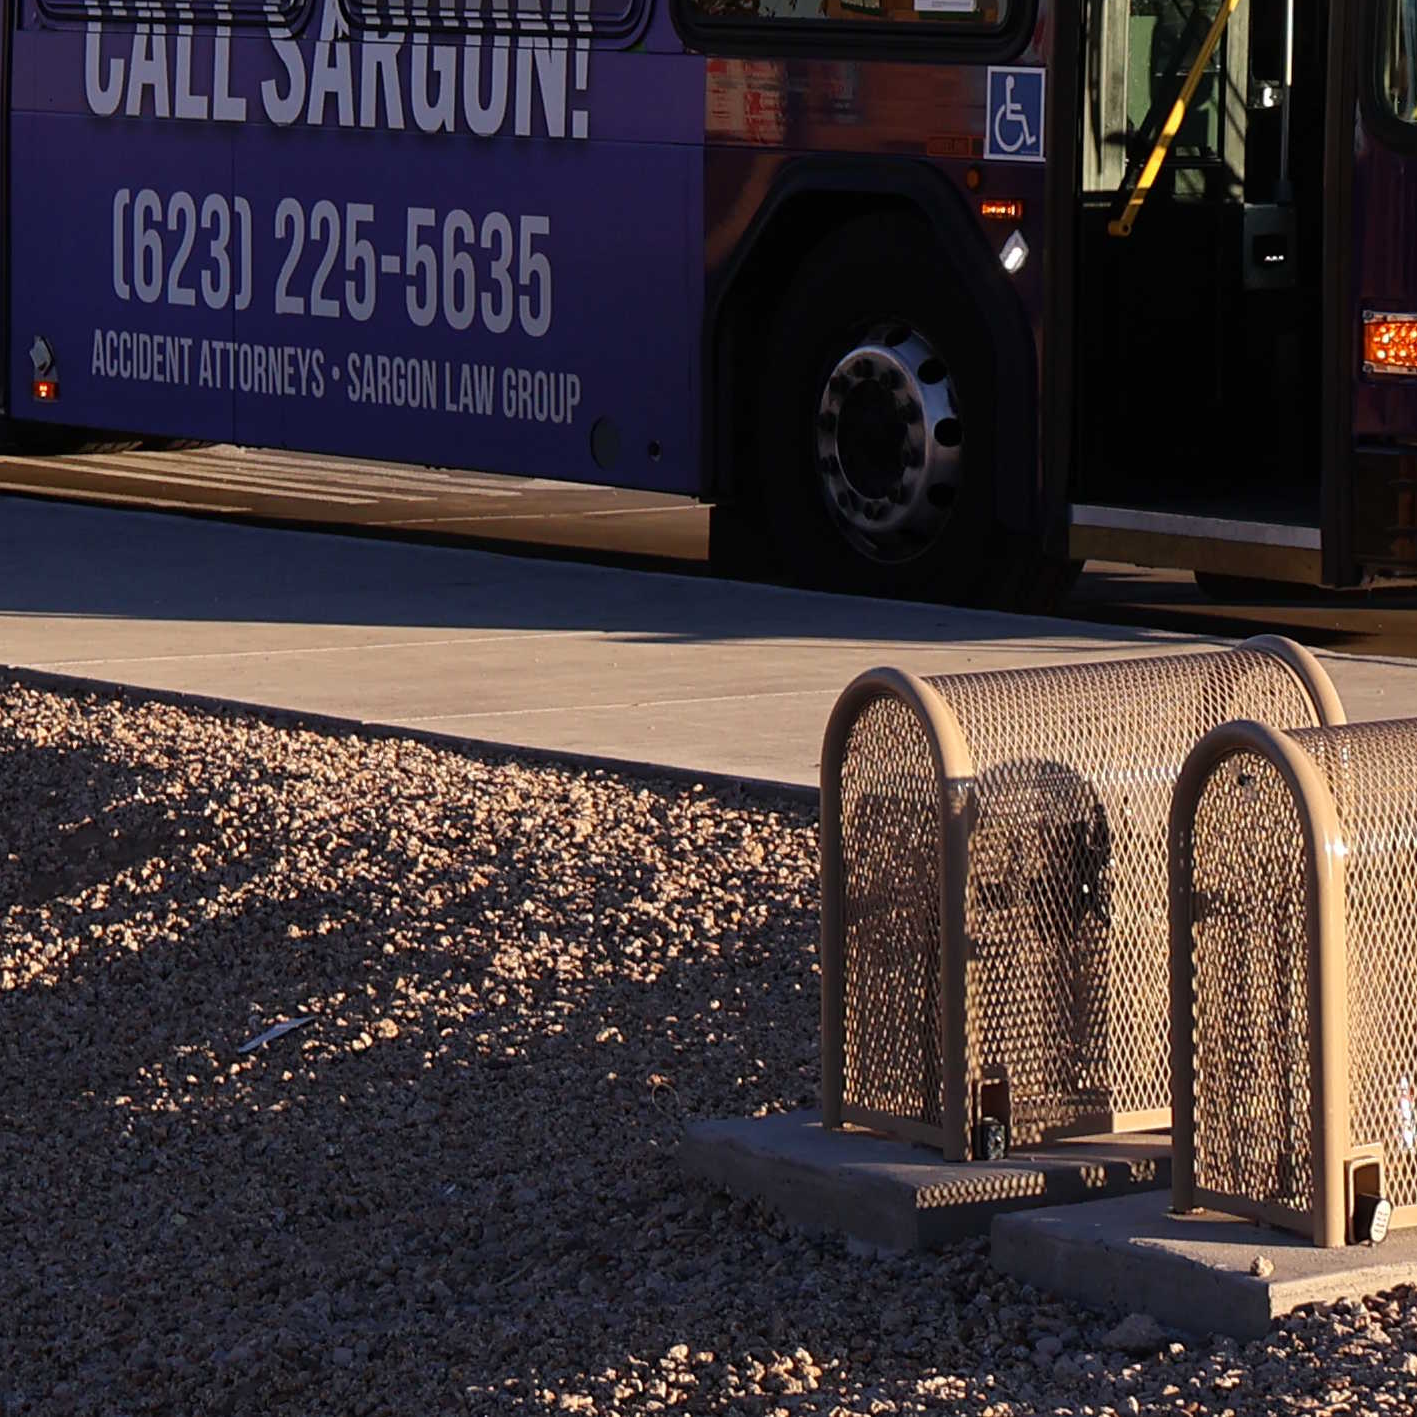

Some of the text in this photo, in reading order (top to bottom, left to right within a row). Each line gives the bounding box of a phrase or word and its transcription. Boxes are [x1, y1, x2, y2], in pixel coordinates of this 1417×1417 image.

[112, 188, 553, 337] (623) 225-5635
[91, 328, 582, 424] ACCIDENT ATTORNEYS SARGON LAW GROUP
